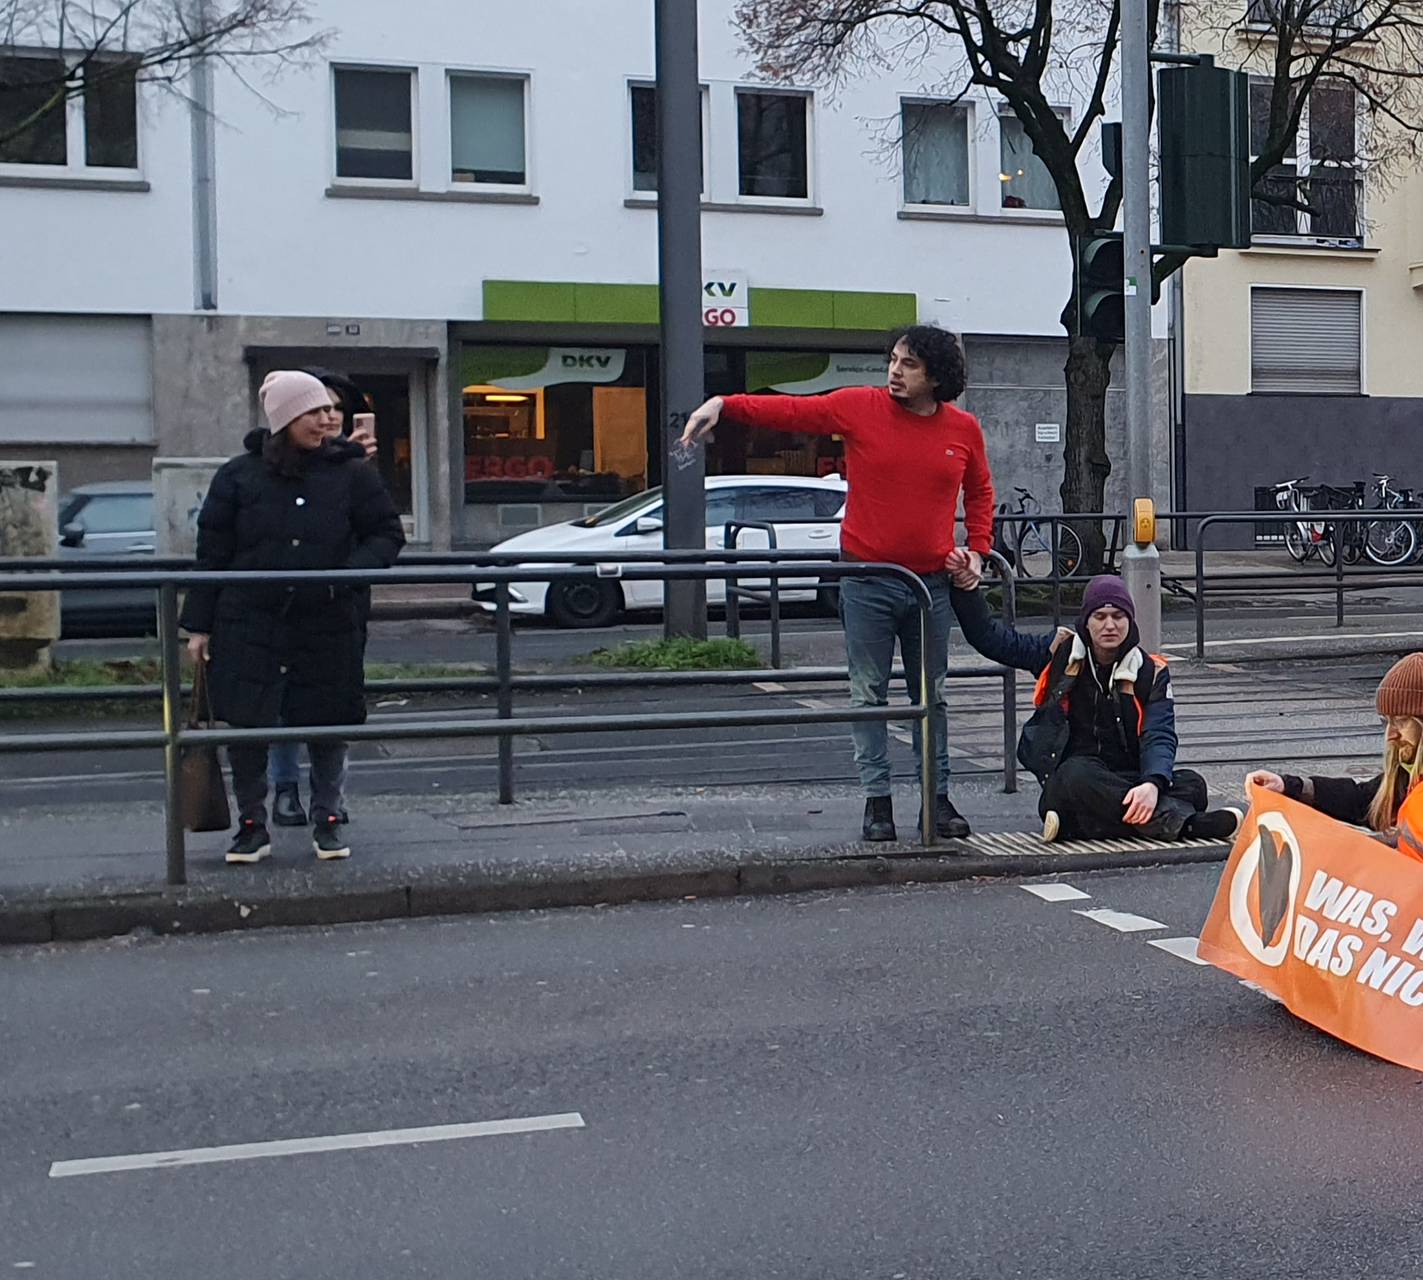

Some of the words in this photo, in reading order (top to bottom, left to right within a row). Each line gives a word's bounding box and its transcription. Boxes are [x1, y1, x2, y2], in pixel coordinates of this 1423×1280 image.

[703, 281, 737, 297] KV
[704, 308, 736, 326] GO
[561, 354, 612, 369] DKV
[1303, 869, 1398, 943] WAS,
[1293, 914, 1364, 977] DAS
